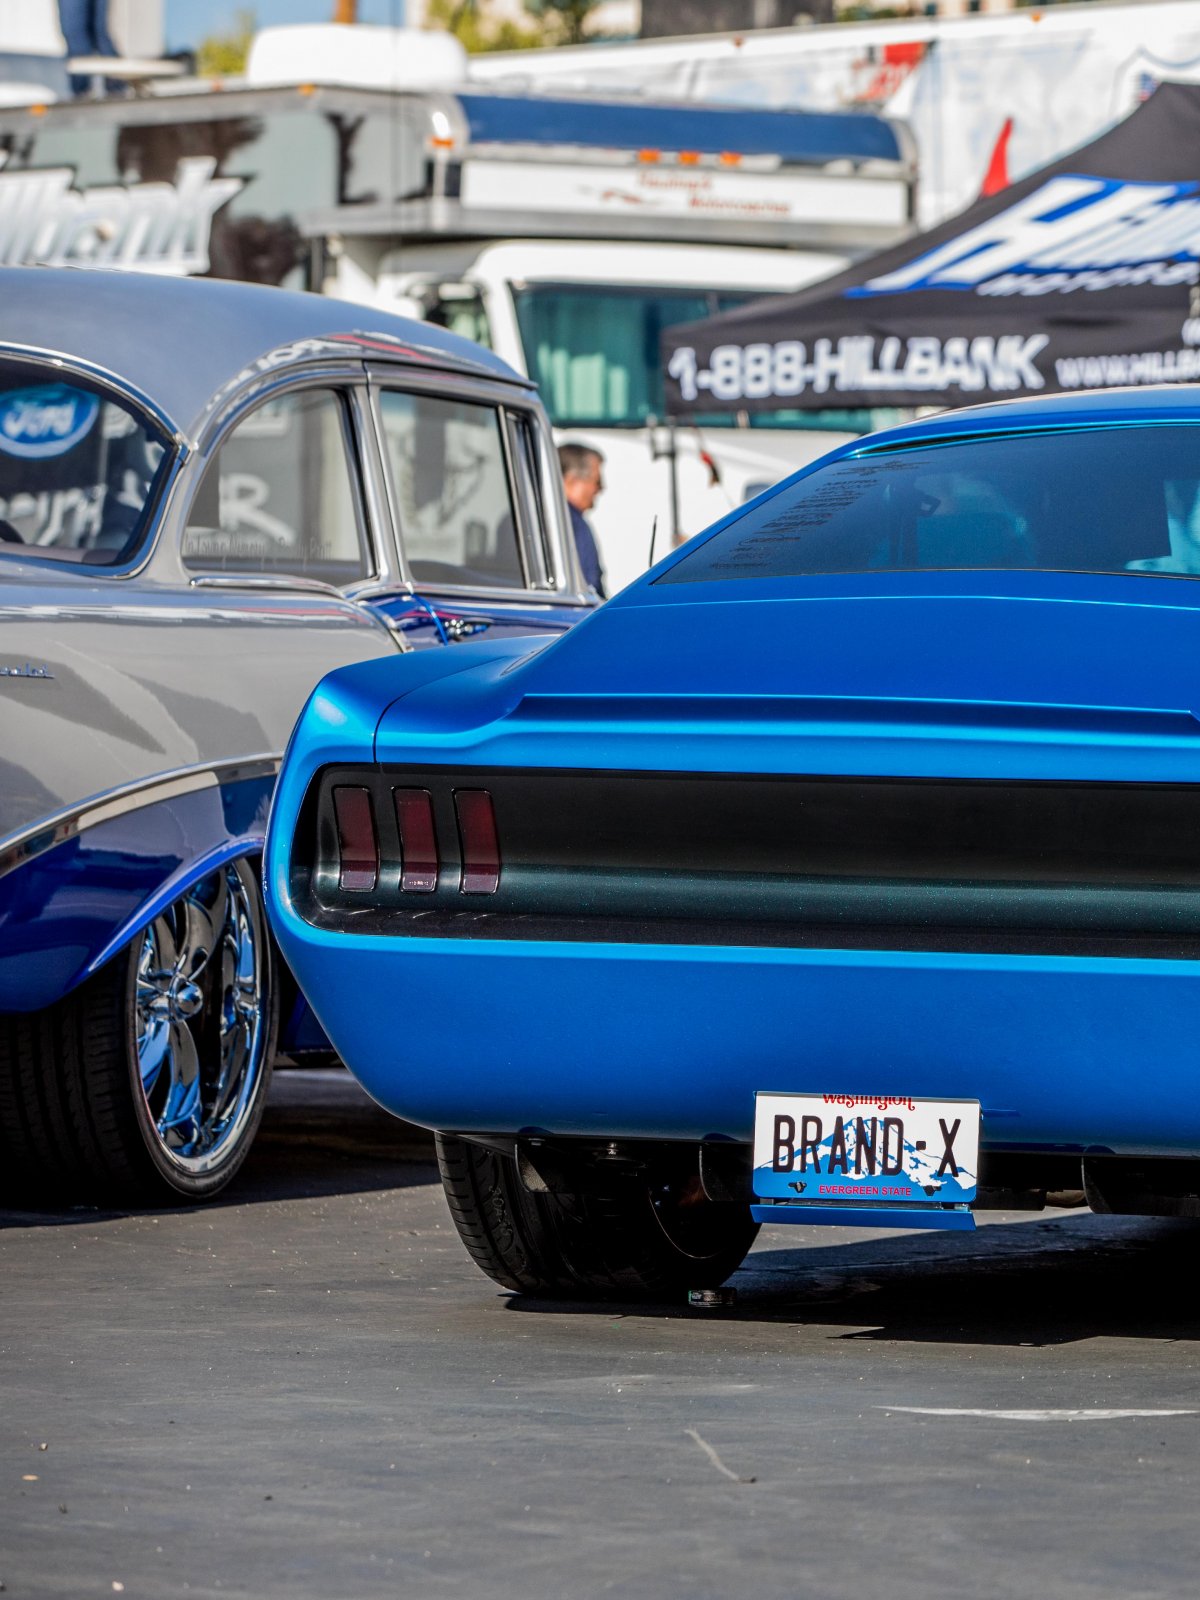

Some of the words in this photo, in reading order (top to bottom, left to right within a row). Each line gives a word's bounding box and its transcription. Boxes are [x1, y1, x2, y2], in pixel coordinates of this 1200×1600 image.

[668, 334, 1050, 401] 1-888-HILLBANK
[818, 1185, 878, 1196] EVERGREEN
[881, 1187, 912, 1196] STATE
